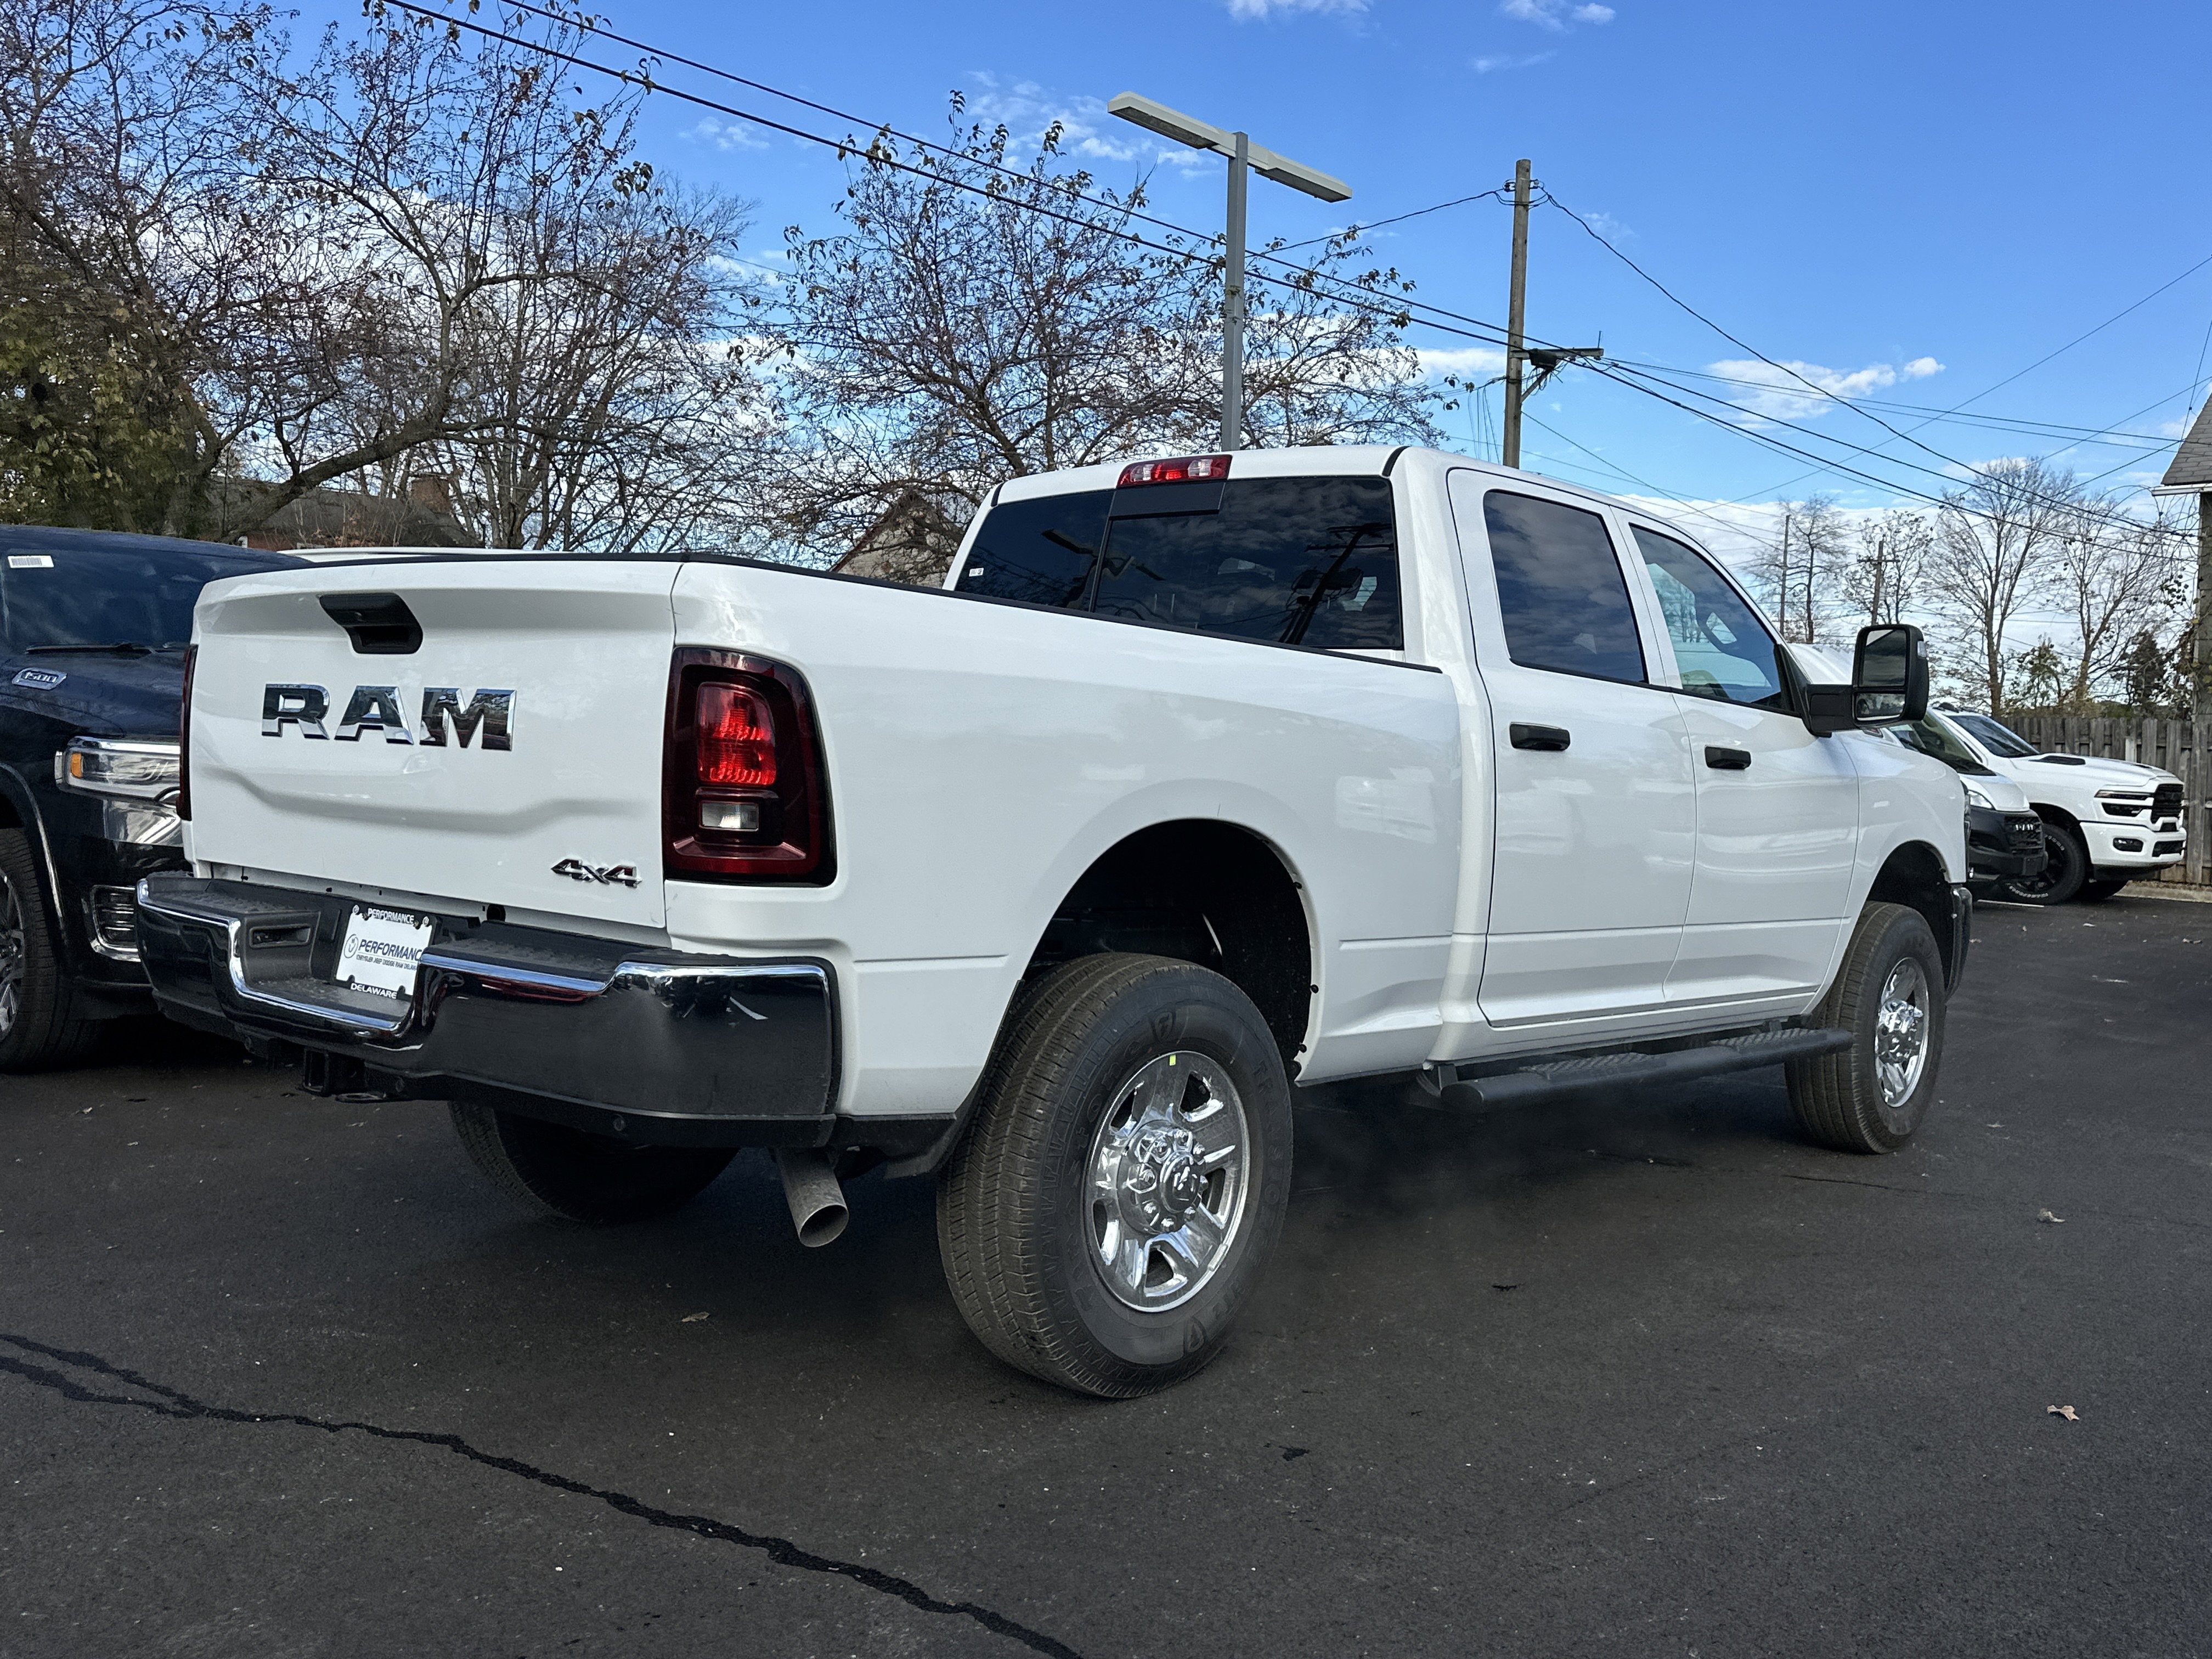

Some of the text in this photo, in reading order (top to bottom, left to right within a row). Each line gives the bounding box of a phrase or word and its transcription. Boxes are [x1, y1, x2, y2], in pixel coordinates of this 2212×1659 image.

[262, 684, 517, 751] RAM
[368, 908, 414, 925] PERFORMANCE
[359, 939, 422, 961] PERFORMANC
[351, 983, 397, 999] DELAWARE
